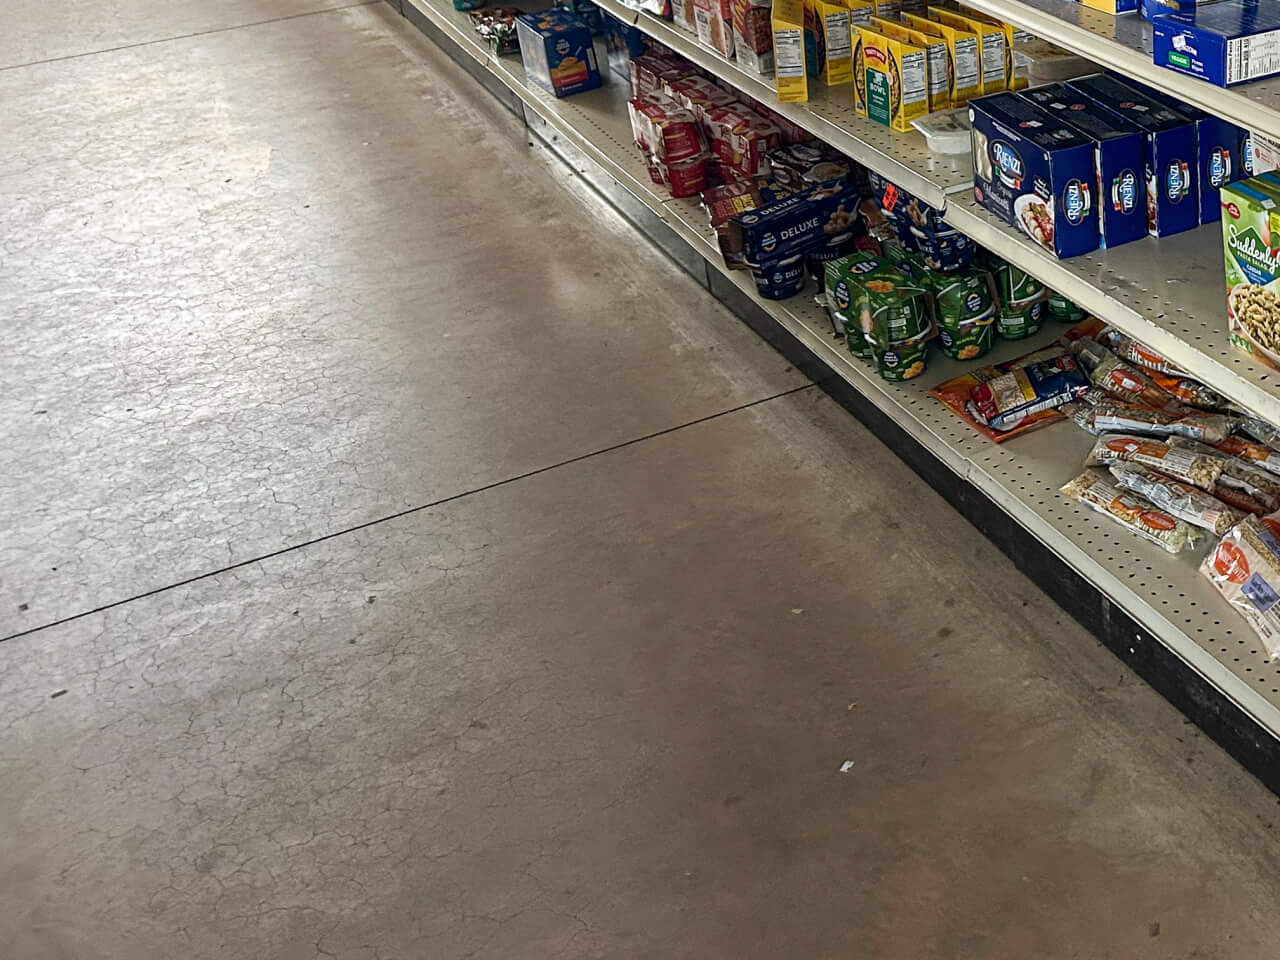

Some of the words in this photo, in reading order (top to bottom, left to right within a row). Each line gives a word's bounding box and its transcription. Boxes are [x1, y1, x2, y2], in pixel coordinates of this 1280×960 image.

[870, 83, 887, 95] BOWL
[993, 143, 1022, 177] RIENZI
[1212, 150, 1222, 187] RIENZI
[1123, 174, 1135, 211] RIENZI
[1169, 162, 1180, 200] RIENZI
[760, 197, 799, 216] DELUXE
[1067, 180, 1079, 220] RIENZI
[781, 218, 820, 240] DELUXE
[1228, 224, 1280, 275] Suddenly!
